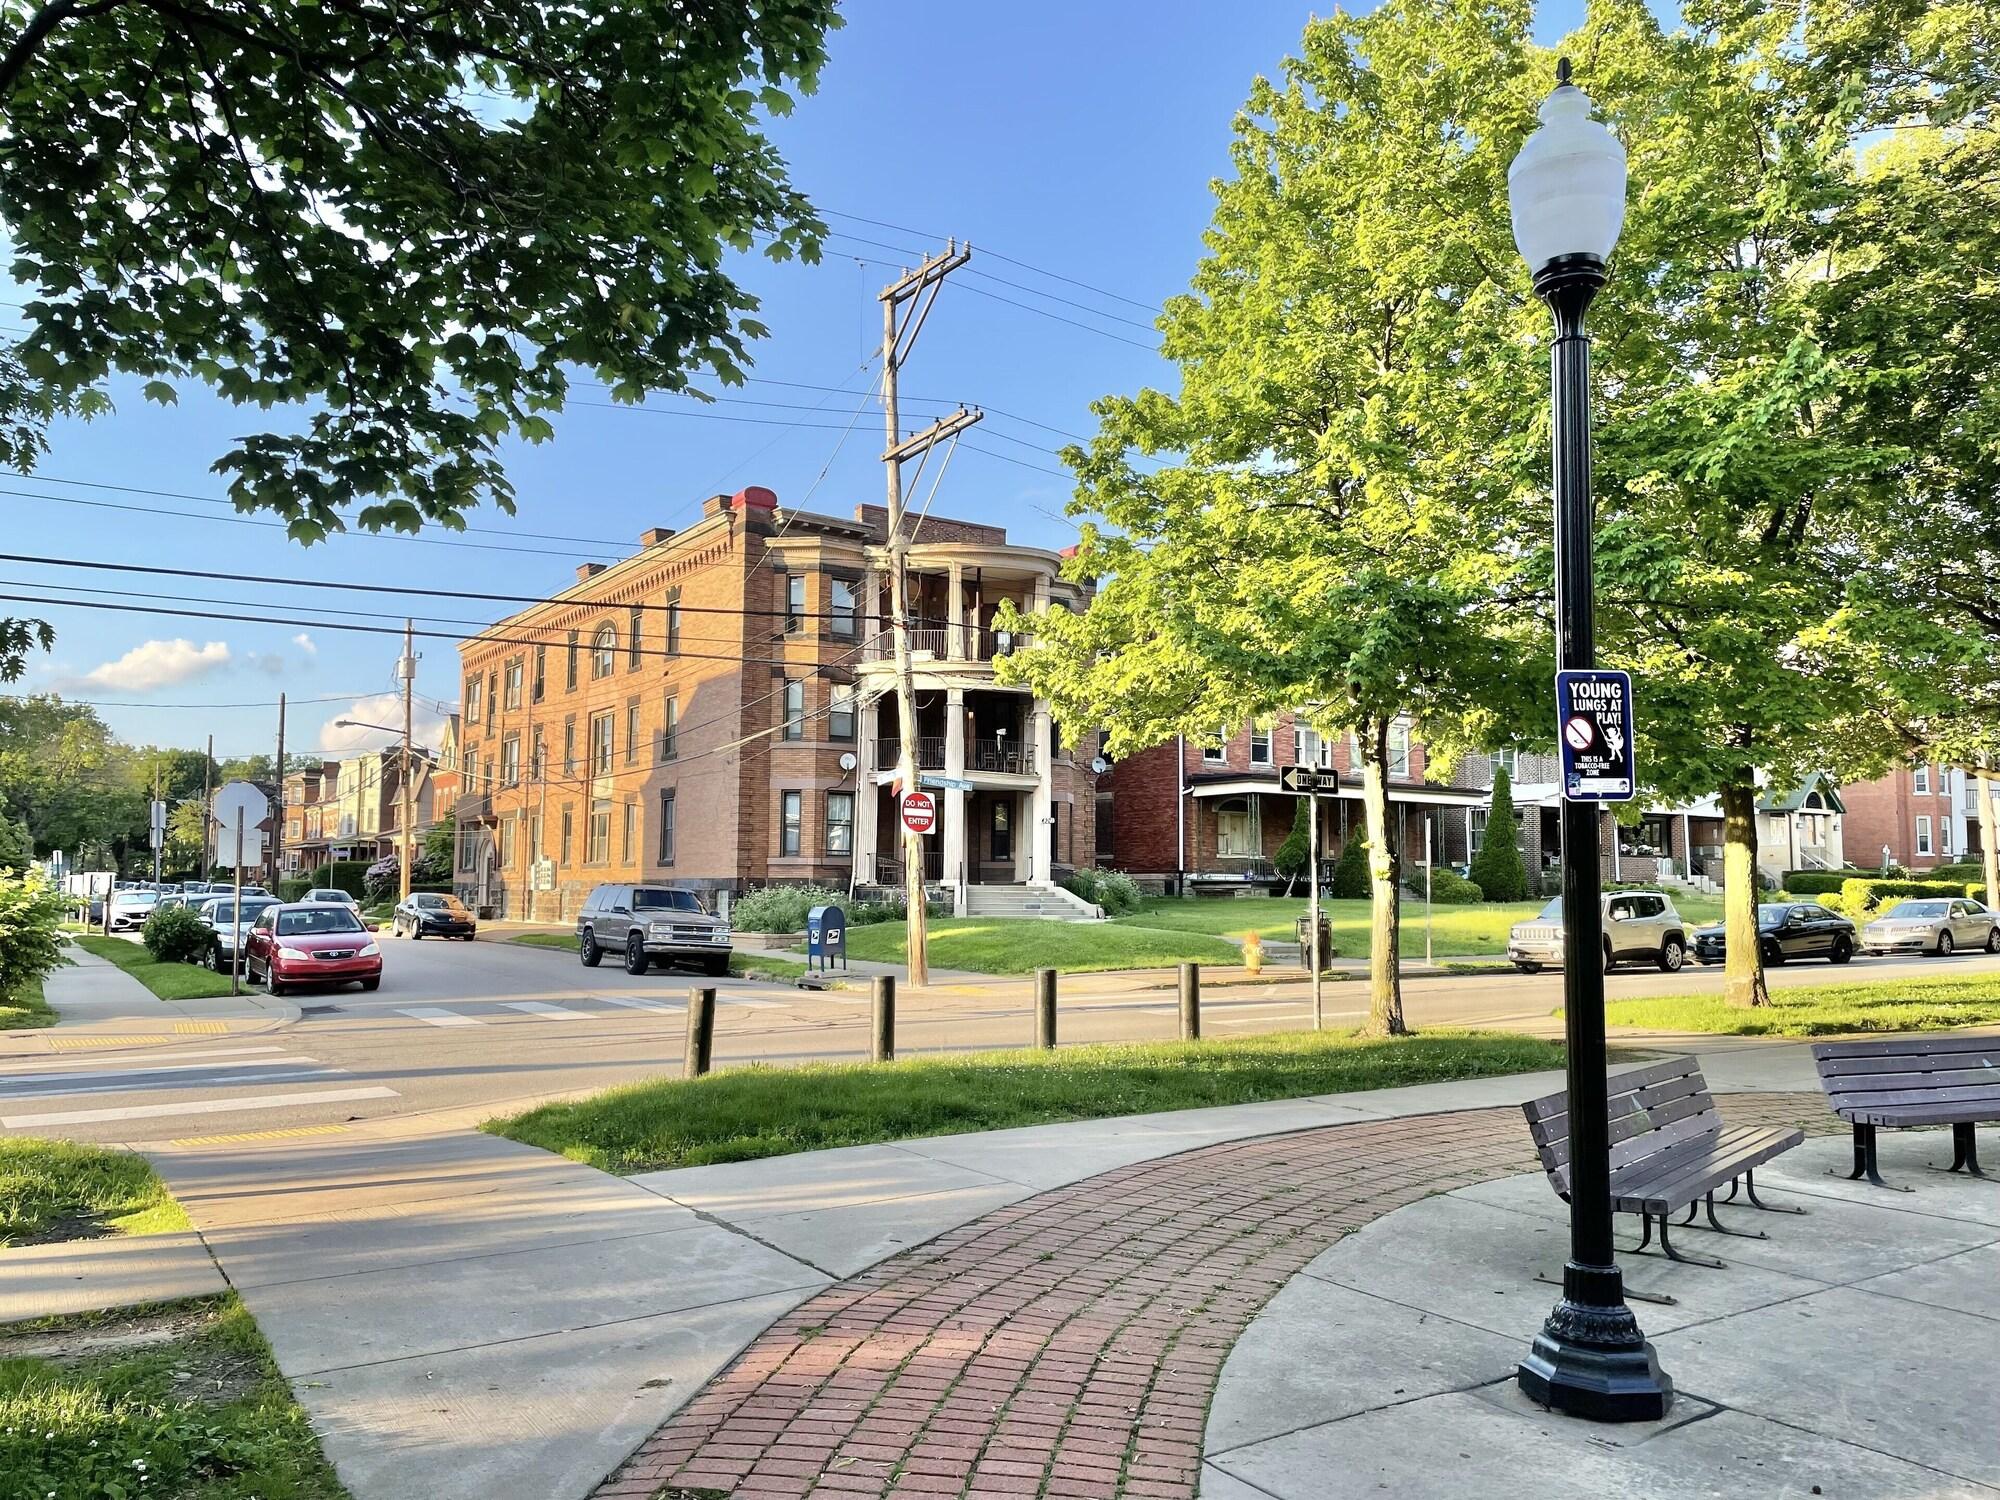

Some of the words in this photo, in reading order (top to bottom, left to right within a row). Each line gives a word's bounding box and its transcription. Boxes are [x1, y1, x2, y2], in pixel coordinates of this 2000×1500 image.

[1568, 682, 1622, 698] YOUNG
[1574, 699, 1607, 711] LUNGS
[1610, 700, 1622, 712] AT
[1596, 712, 1622, 724] PLAY!
[922, 777, 956, 788] Friendship
[1297, 774, 1311, 785] ONE
[908, 818, 928, 826] ENTER
